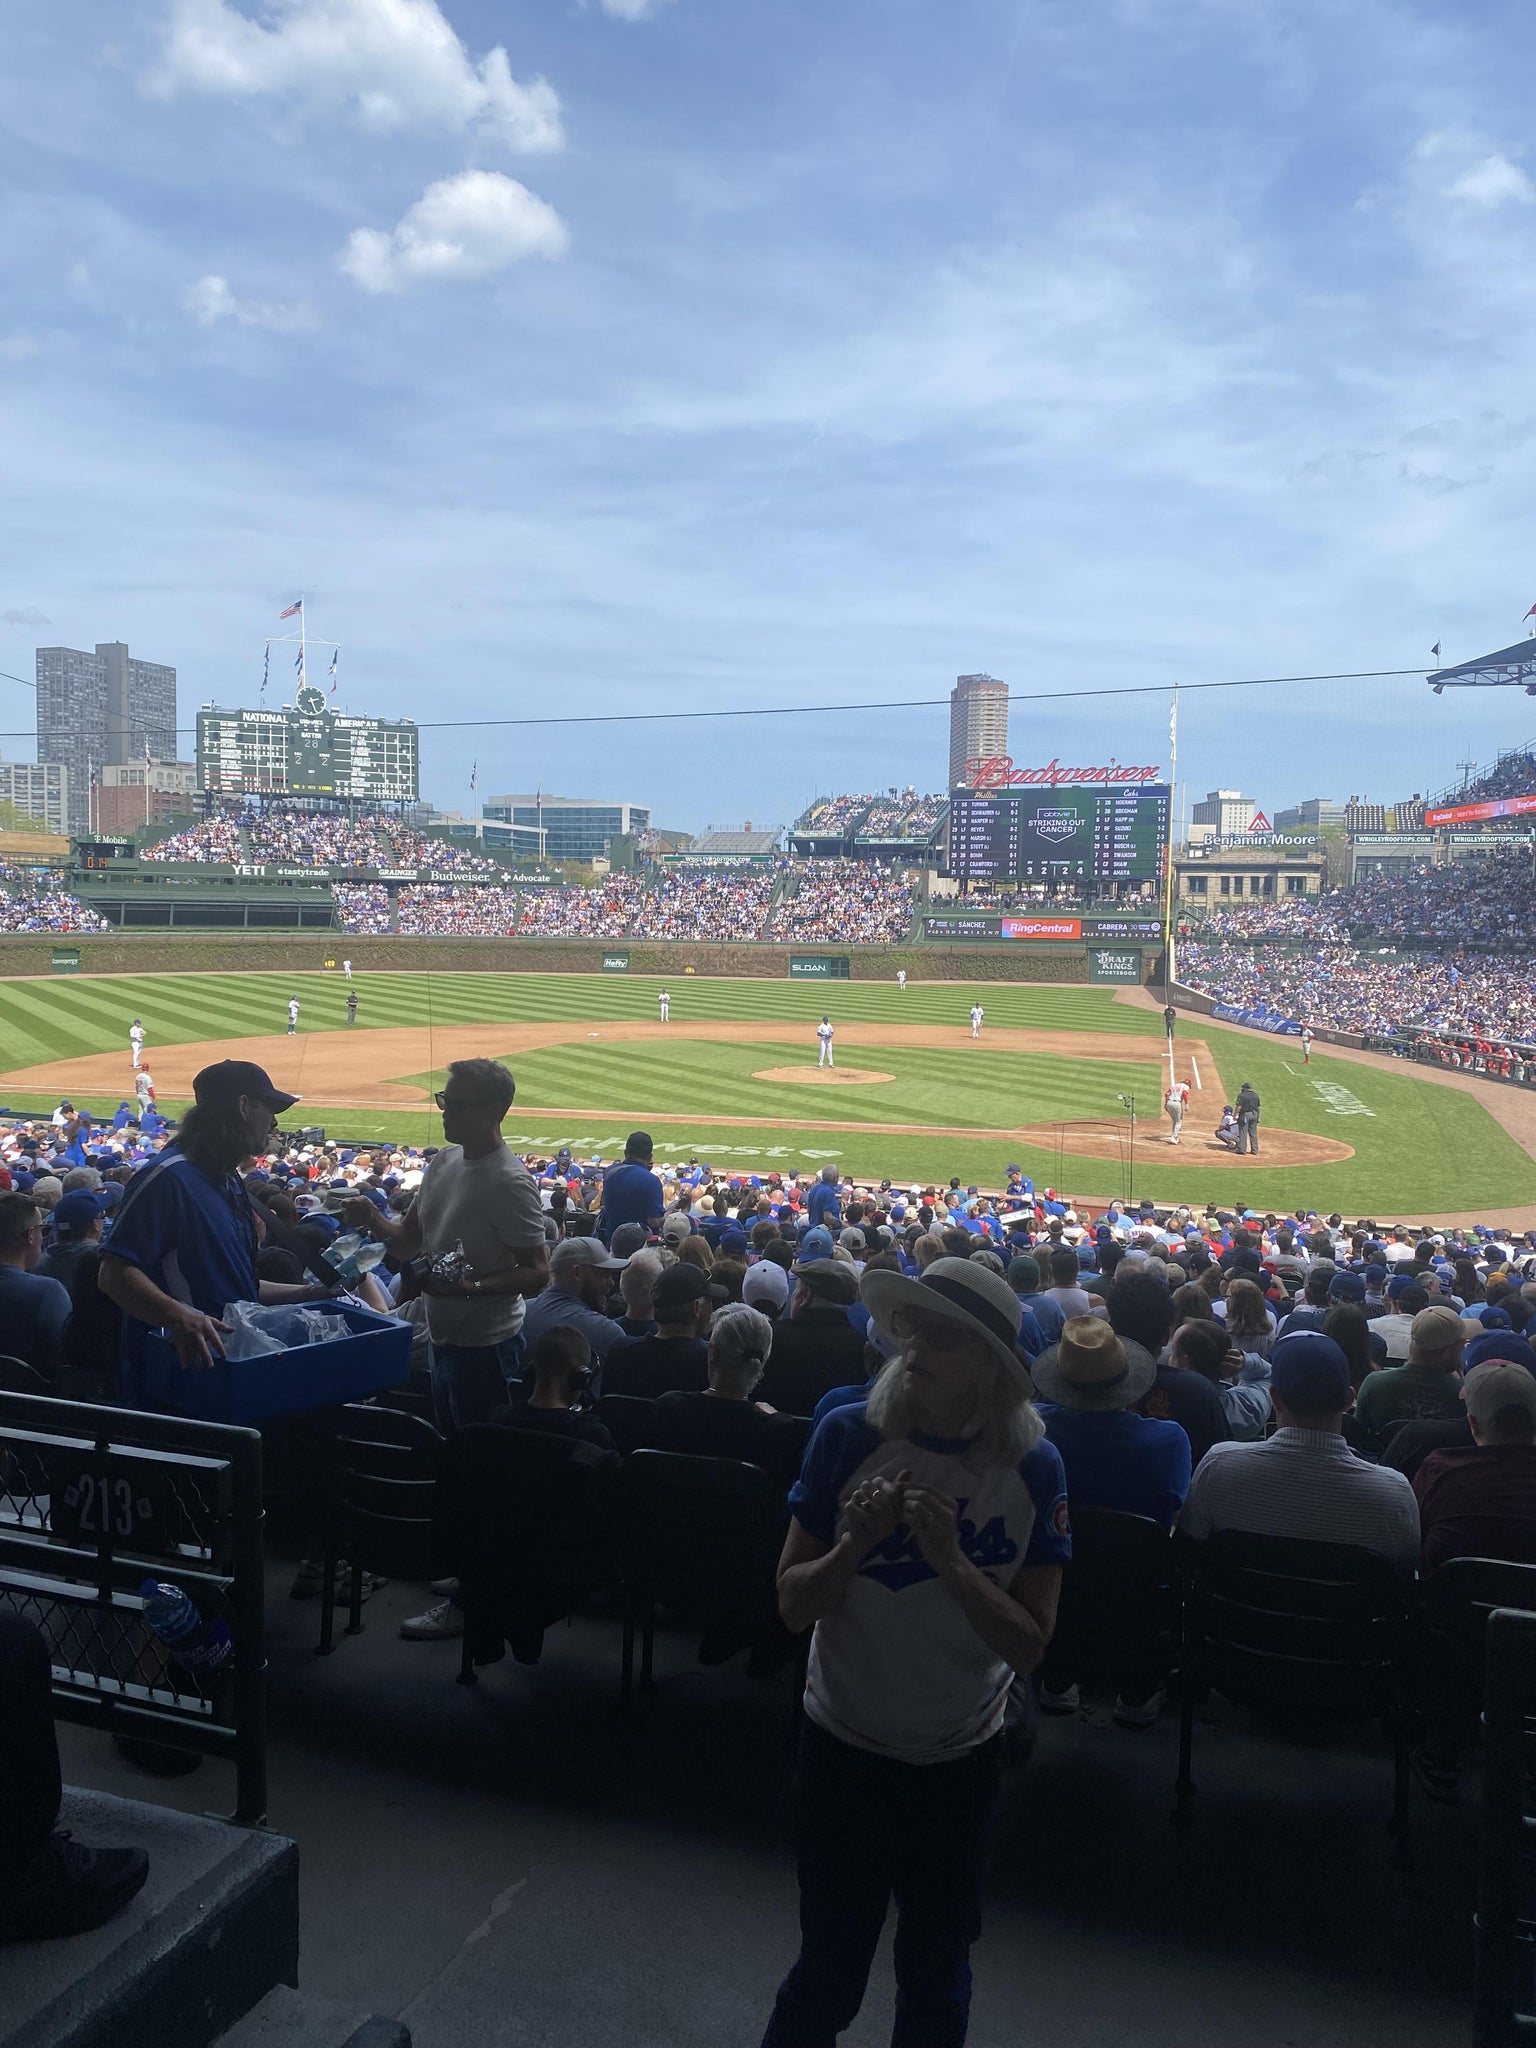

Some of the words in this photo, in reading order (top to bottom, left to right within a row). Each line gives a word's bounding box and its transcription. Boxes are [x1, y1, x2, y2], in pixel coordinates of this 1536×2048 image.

[243, 713, 288, 723] NATIONAL
[305, 740, 318, 748] 28
[295, 756, 301, 764] 2
[966, 757, 1160, 789] Budweiser
[102, 836, 127, 844] Mobile
[1204, 834, 1266, 847] Benjamin
[1272, 834, 1315, 845] Moore
[232, 865, 265, 875] YETI
[284, 869, 329, 877] tastytrade
[431, 871, 489, 881] Budweiser
[1010, 923, 1073, 934] RingCentral
[605, 959, 626, 968] Hefty
[1098, 954, 1134, 964] DRAFT
[79, 1474, 132, 1535] 213
